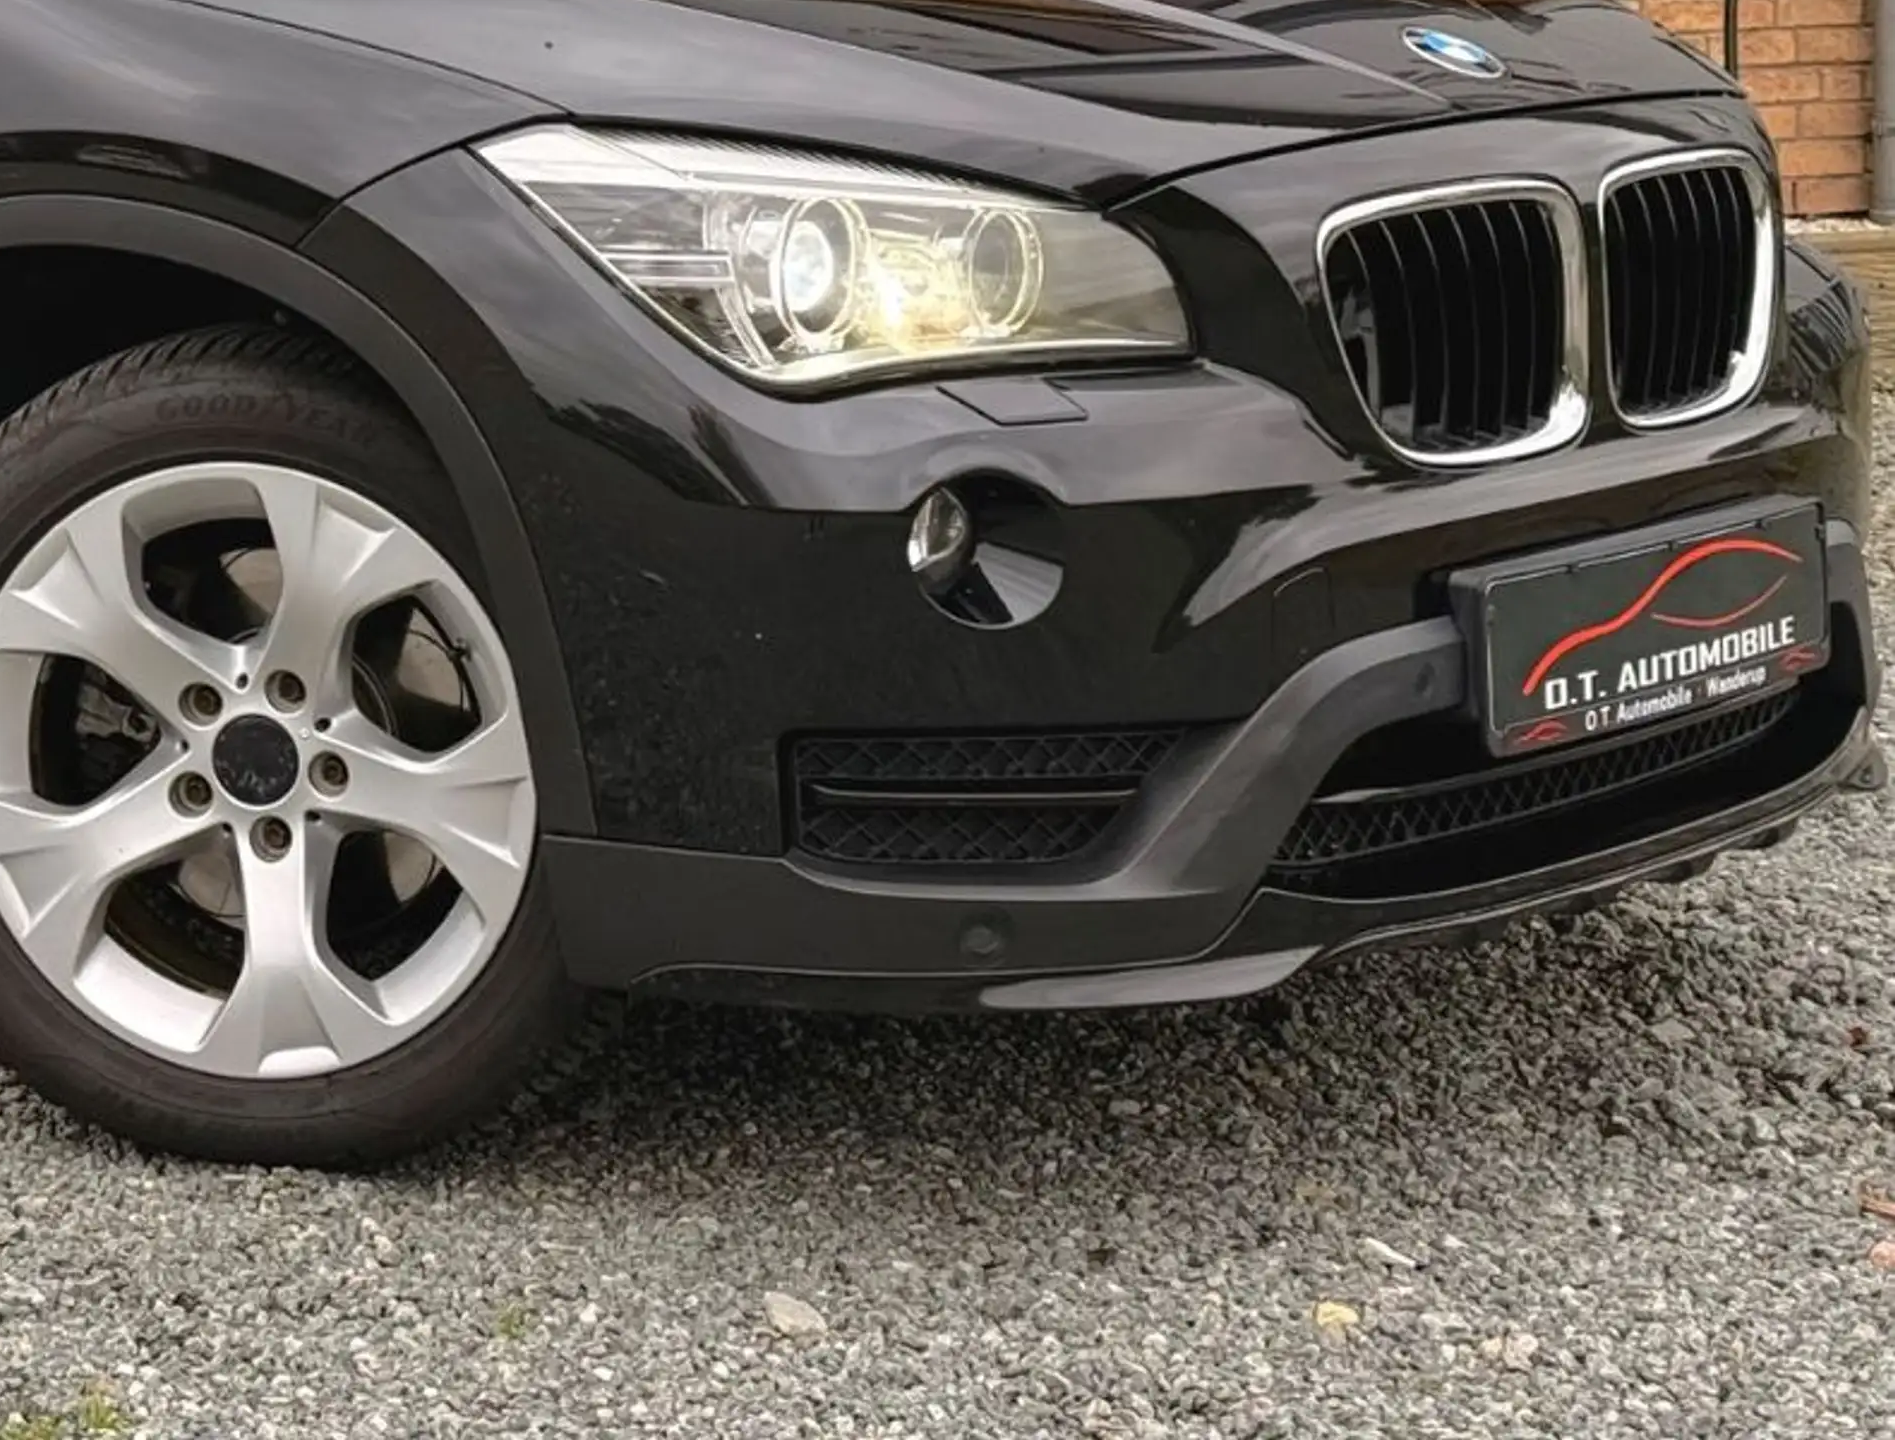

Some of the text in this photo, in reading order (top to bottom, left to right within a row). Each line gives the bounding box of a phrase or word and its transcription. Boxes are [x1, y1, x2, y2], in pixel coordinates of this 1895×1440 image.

[1544, 615, 1796, 710] O.T. AUTOMOBILE
[1616, 684, 1693, 725] Automobile
